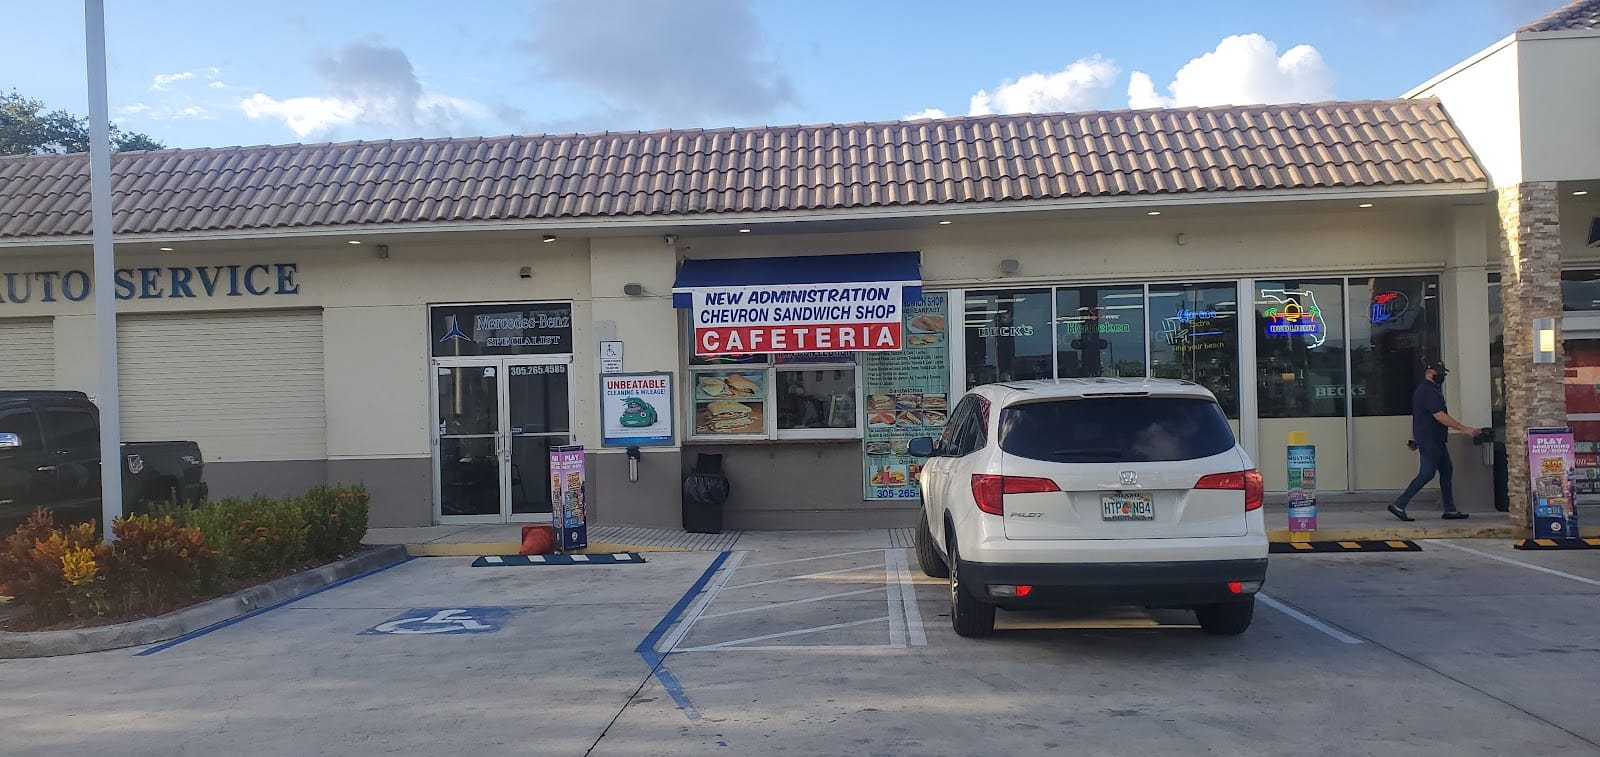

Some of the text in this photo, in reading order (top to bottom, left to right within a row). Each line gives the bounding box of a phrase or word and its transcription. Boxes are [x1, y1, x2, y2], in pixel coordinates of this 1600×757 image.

[0, 263, 299, 303] UTO SERVICE
[705, 287, 890, 306] NEW ADMINISTRATION
[700, 304, 896, 323] CHEVRON SANDWICH SHOP
[476, 314, 570, 331] Mercedes-Benz
[1066, 321, 1130, 334] Heineken
[702, 326, 895, 351] CAFETERIA
[978, 324, 1034, 338] BECK'S
[486, 336, 561, 347] SPECIALIST
[607, 379, 666, 390] UNBEATABLE
[1536, 437, 1563, 445] PLAY
